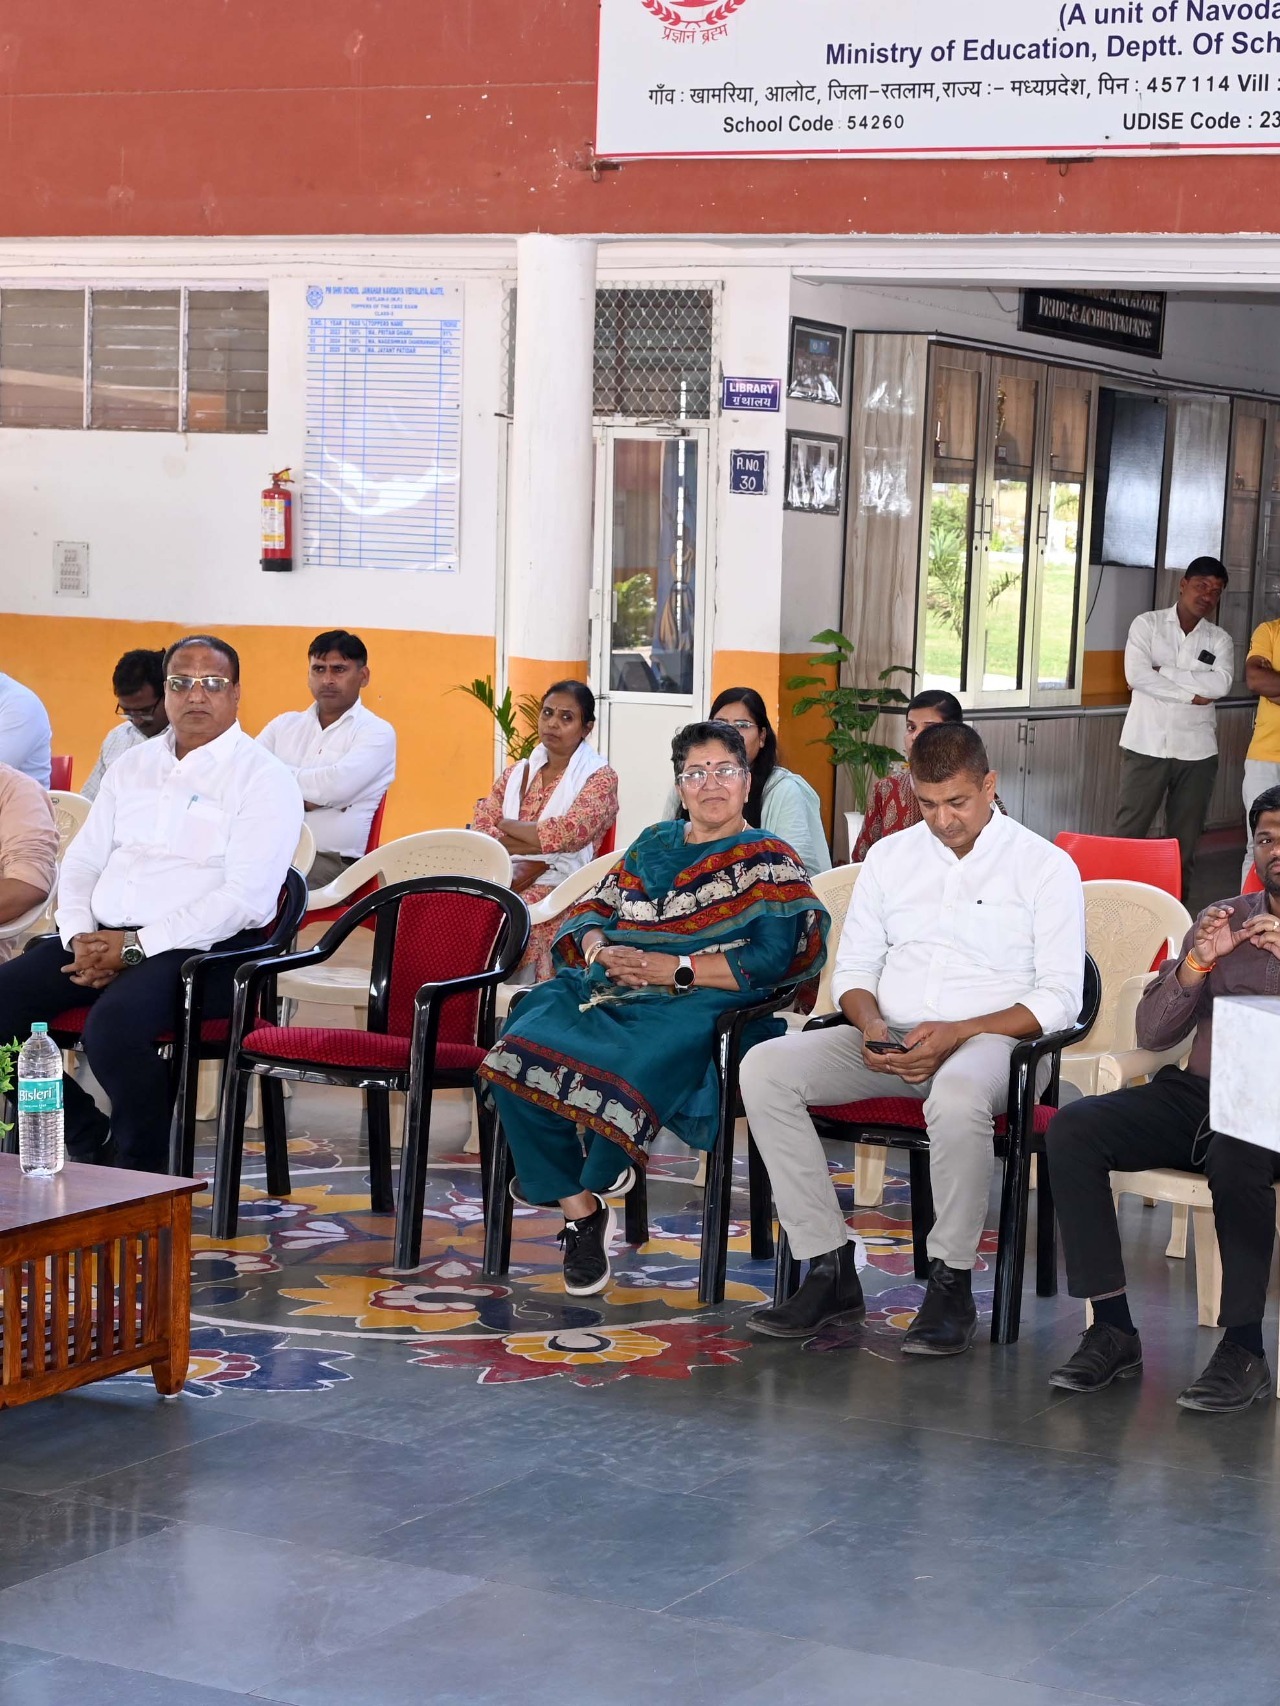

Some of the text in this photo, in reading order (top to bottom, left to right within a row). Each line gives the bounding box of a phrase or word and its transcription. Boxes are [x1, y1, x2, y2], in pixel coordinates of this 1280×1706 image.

[1060, 4, 1086, 31] (A
[1094, 2, 1143, 24] unit
[1152, 0, 1178, 22] of
[826, 43, 922, 68] Ministry
[931, 40, 956, 61] of
[963, 37, 1097, 61] Education,
[1107, 35, 1182, 62] Deptt.
[1192, 32, 1224, 55] Of
[649, 84, 676, 105] गाँव
[690, 81, 758, 106] खामरिया,
[765, 80, 821, 105] आलोट,
[1011, 73, 1091, 99] मध्यप्रदेश,
[1098, 71, 1130, 95] पिन
[1147, 76, 1230, 93] 457114
[1237, 74, 1269, 92] Vill
[723, 116, 783, 133] School
[788, 115, 834, 132] Code
[847, 115, 905, 130] 54260
[1123, 113, 1184, 131] UDISE
[1190, 112, 1241, 130] Code
[729, 382, 775, 394] LIBRARY
[740, 476, 757, 490] 30
[20, 1088, 53, 1102] Bisleri
